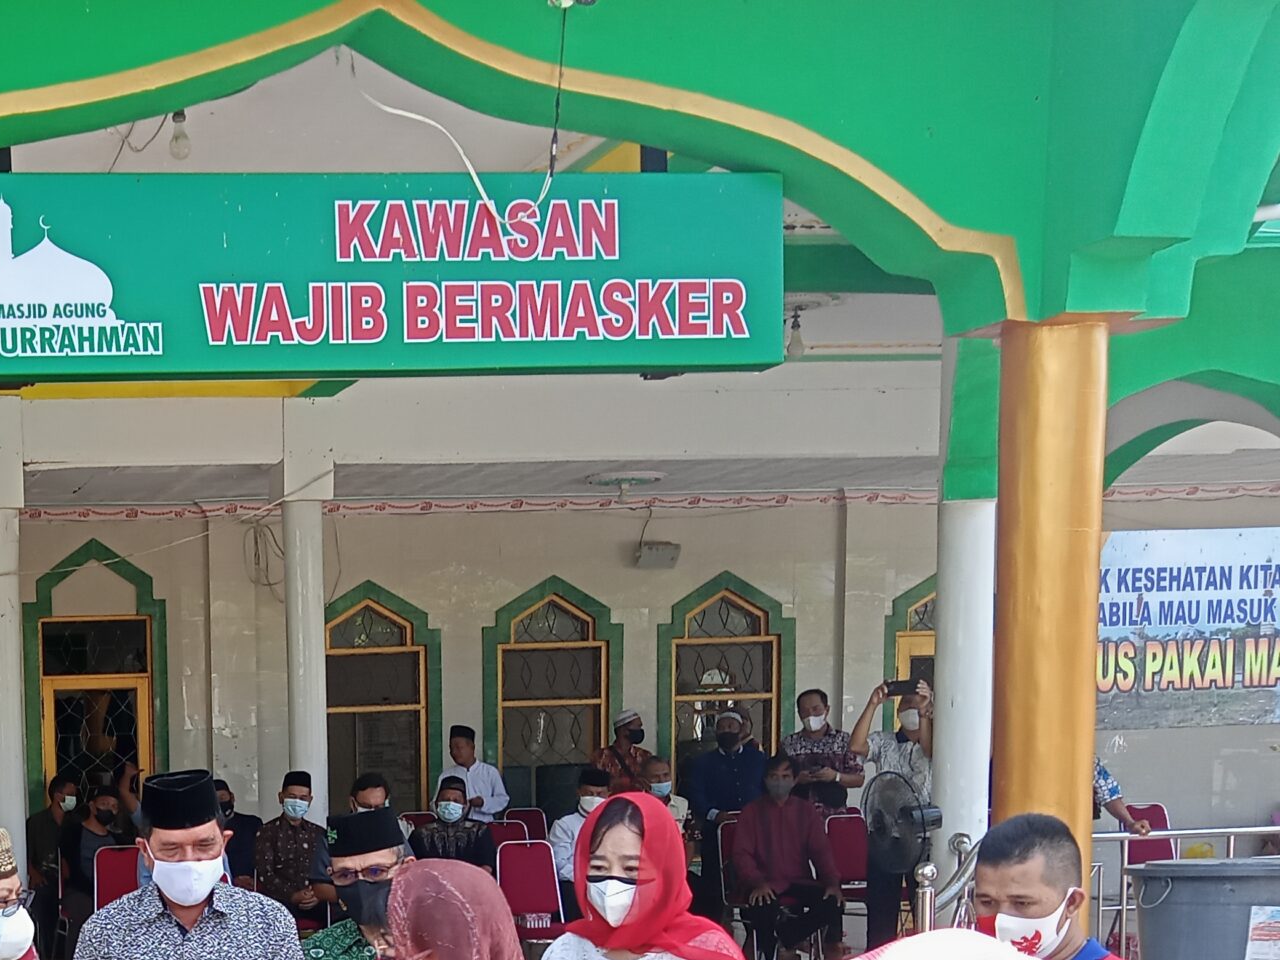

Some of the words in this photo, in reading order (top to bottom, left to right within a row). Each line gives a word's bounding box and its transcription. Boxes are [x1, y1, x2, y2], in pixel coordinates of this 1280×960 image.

[333, 198, 621, 262] KAWASAN
[52, 302, 107, 318] AGUNG
[199, 283, 387, 346] WAJIB
[403, 277, 751, 344] BERMASKER
[1117, 565, 1233, 594] KESEHATAN
[1158, 599, 1201, 626] MAU
[1206, 597, 1277, 625] MASUK
[1143, 637, 1235, 691] PAKAI
